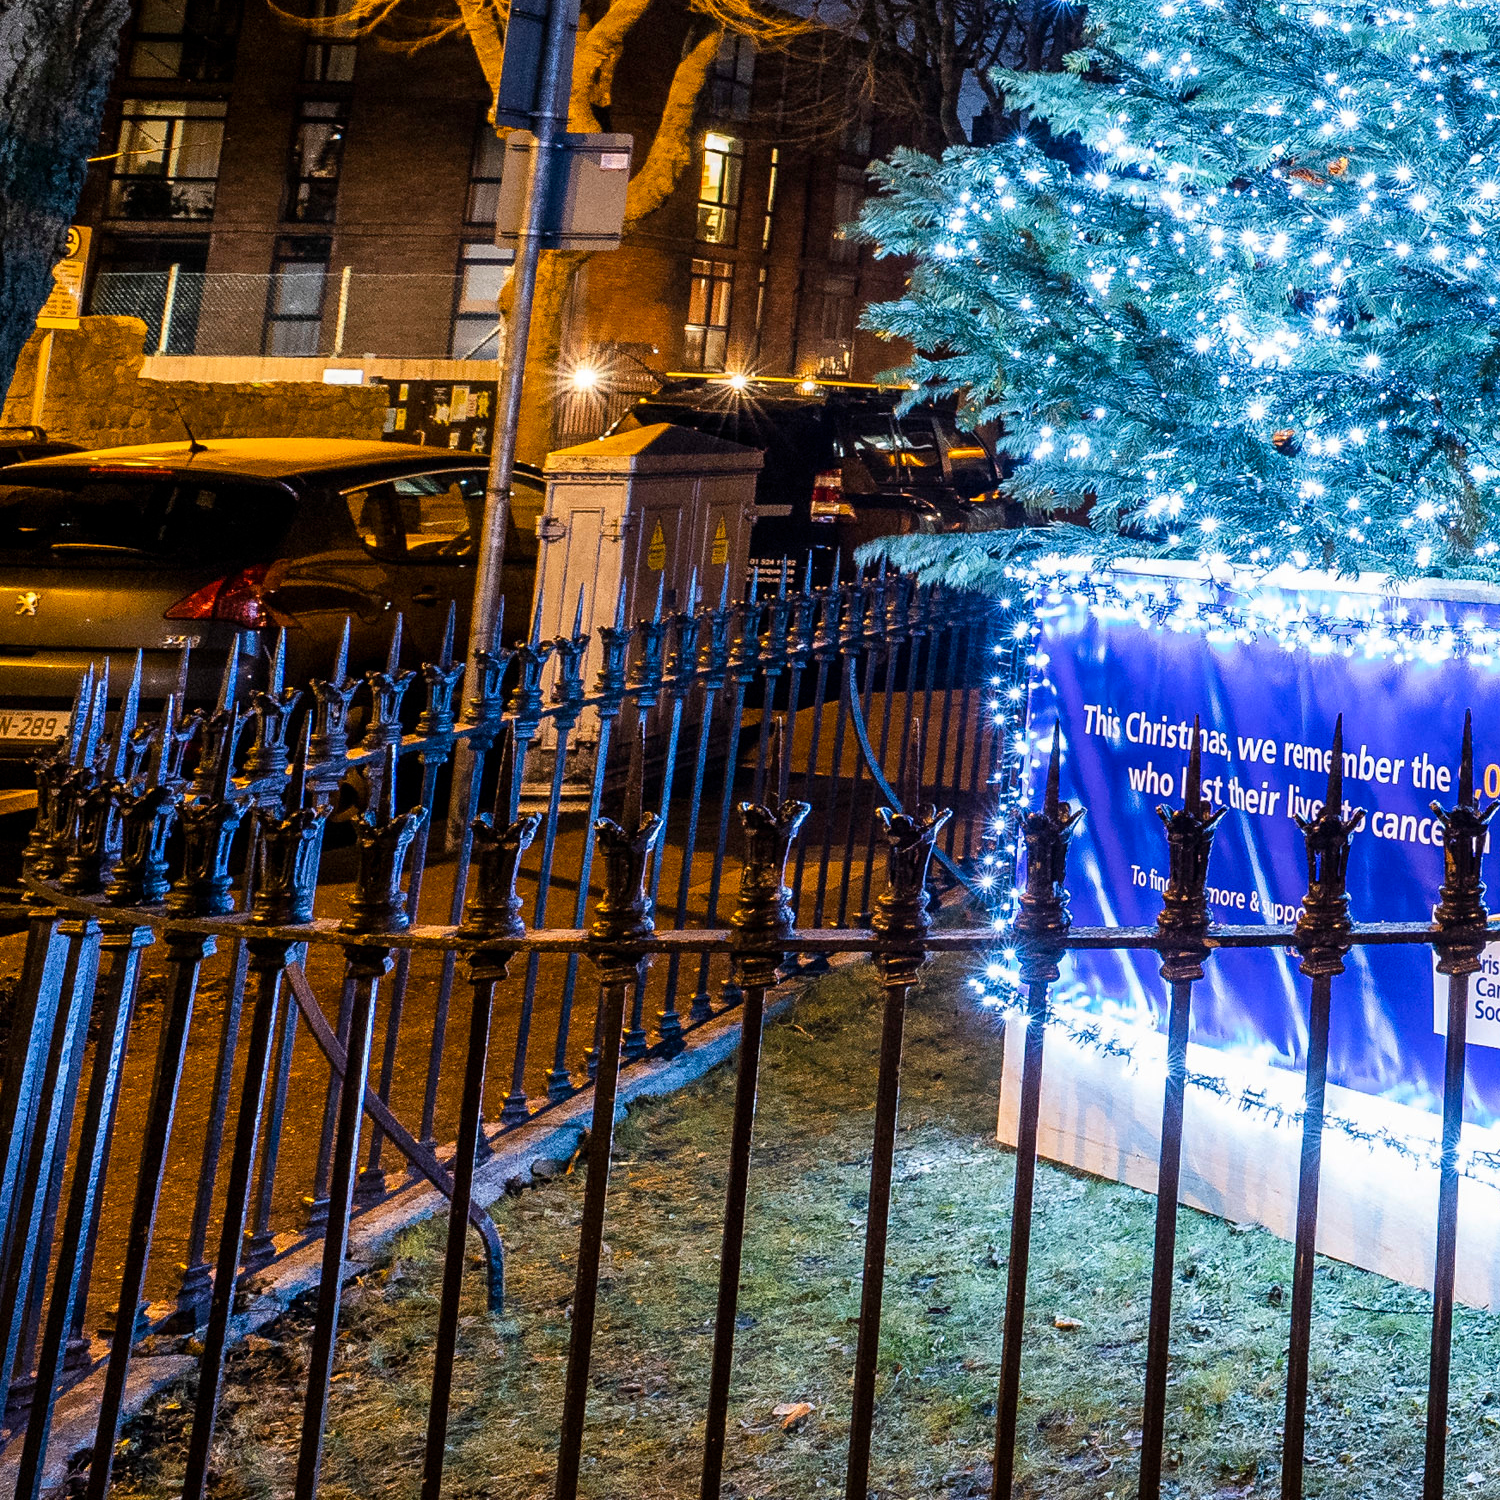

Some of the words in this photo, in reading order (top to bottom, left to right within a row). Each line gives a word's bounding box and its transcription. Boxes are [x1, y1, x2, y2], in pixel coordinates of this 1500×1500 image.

[1083, 704, 1120, 739] This
[1126, 712, 1231, 762] Christmas,
[1237, 736, 1276, 764] we
[1284, 741, 1404, 785] remember
[1411, 753, 1451, 792] the
[1128, 761, 1174, 797] who
[1181, 766, 1223, 805] lst
[1228, 776, 1280, 816] their
[1287, 783, 1327, 820] live
[1371, 811, 1445, 847] cance
[1131, 865, 1147, 887] To
[1207, 887, 1245, 909] more
[1249, 891, 1260, 913] &
[1261, 900, 1306, 924] suppo
